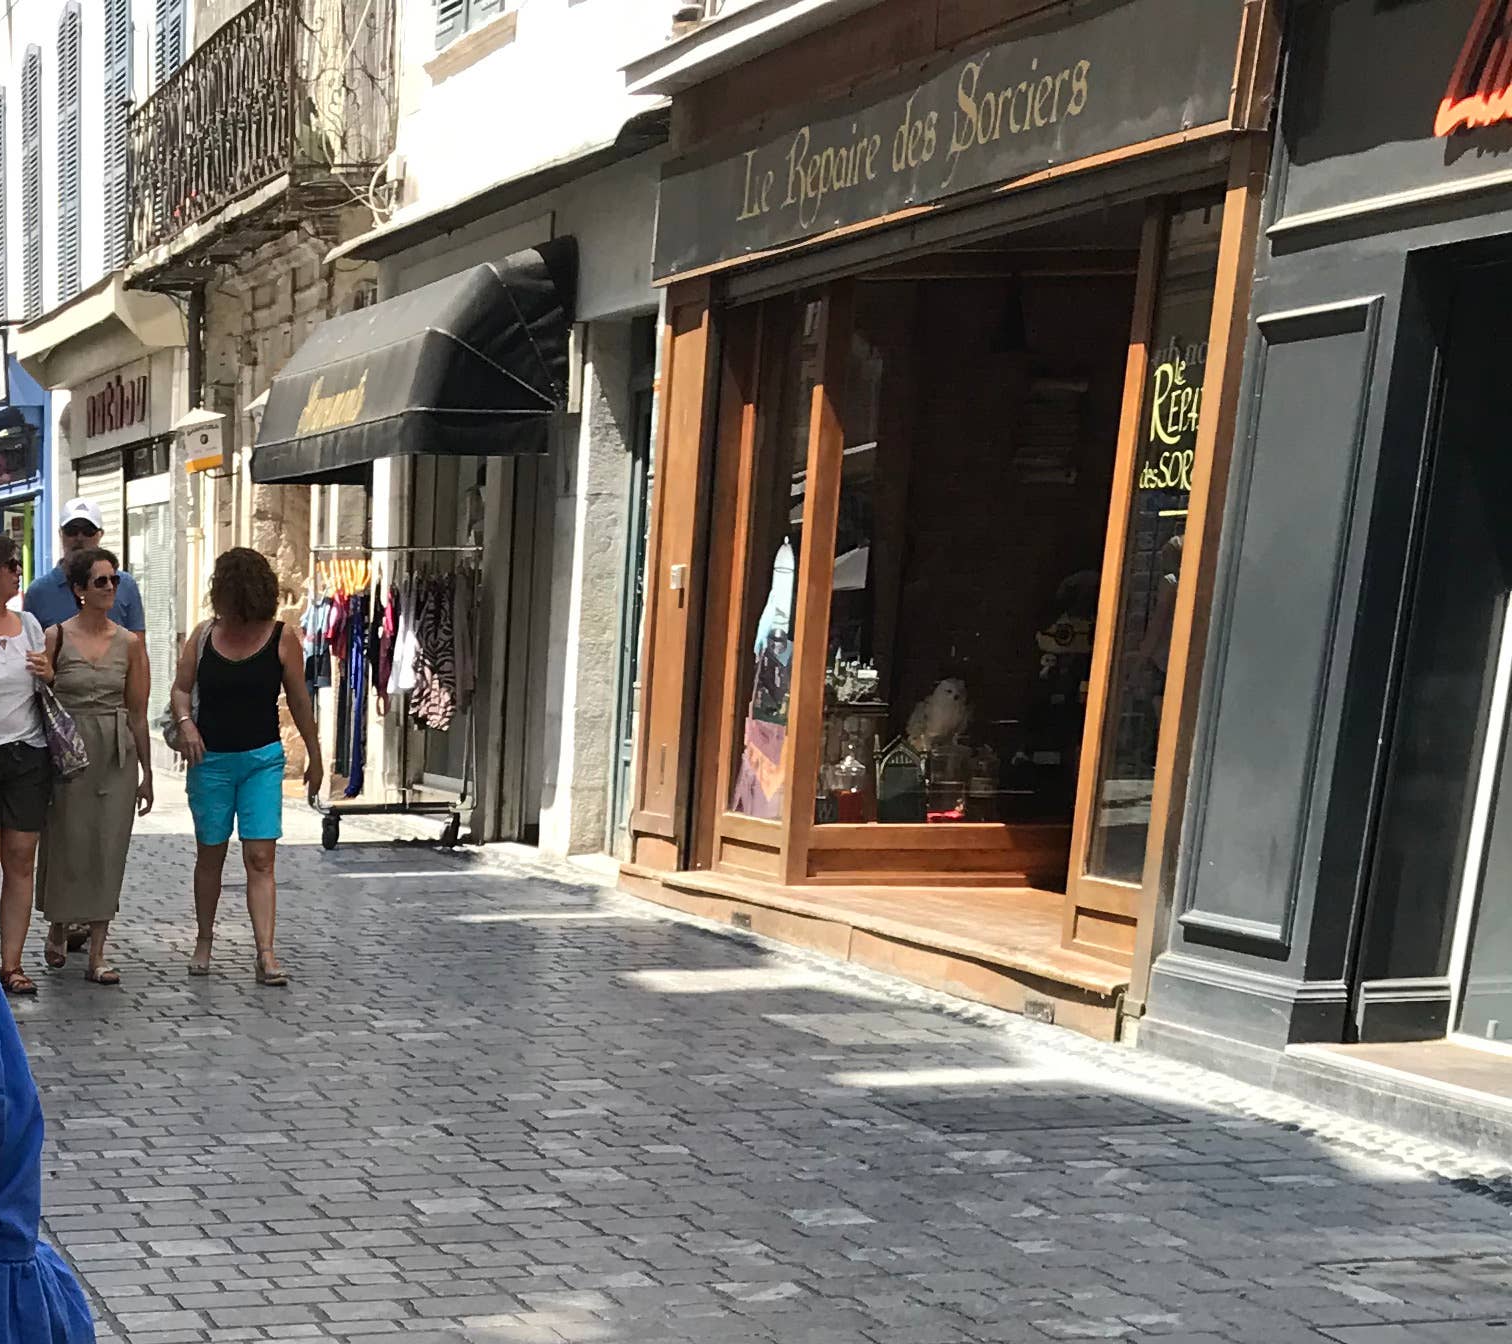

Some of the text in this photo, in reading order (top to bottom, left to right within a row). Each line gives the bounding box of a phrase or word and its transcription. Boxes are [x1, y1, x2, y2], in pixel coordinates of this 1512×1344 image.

[737, 52, 1090, 229] Le Repaire des Sorciers
[1150, 363, 1203, 444] REPA
[1158, 450, 1194, 490] SOR
